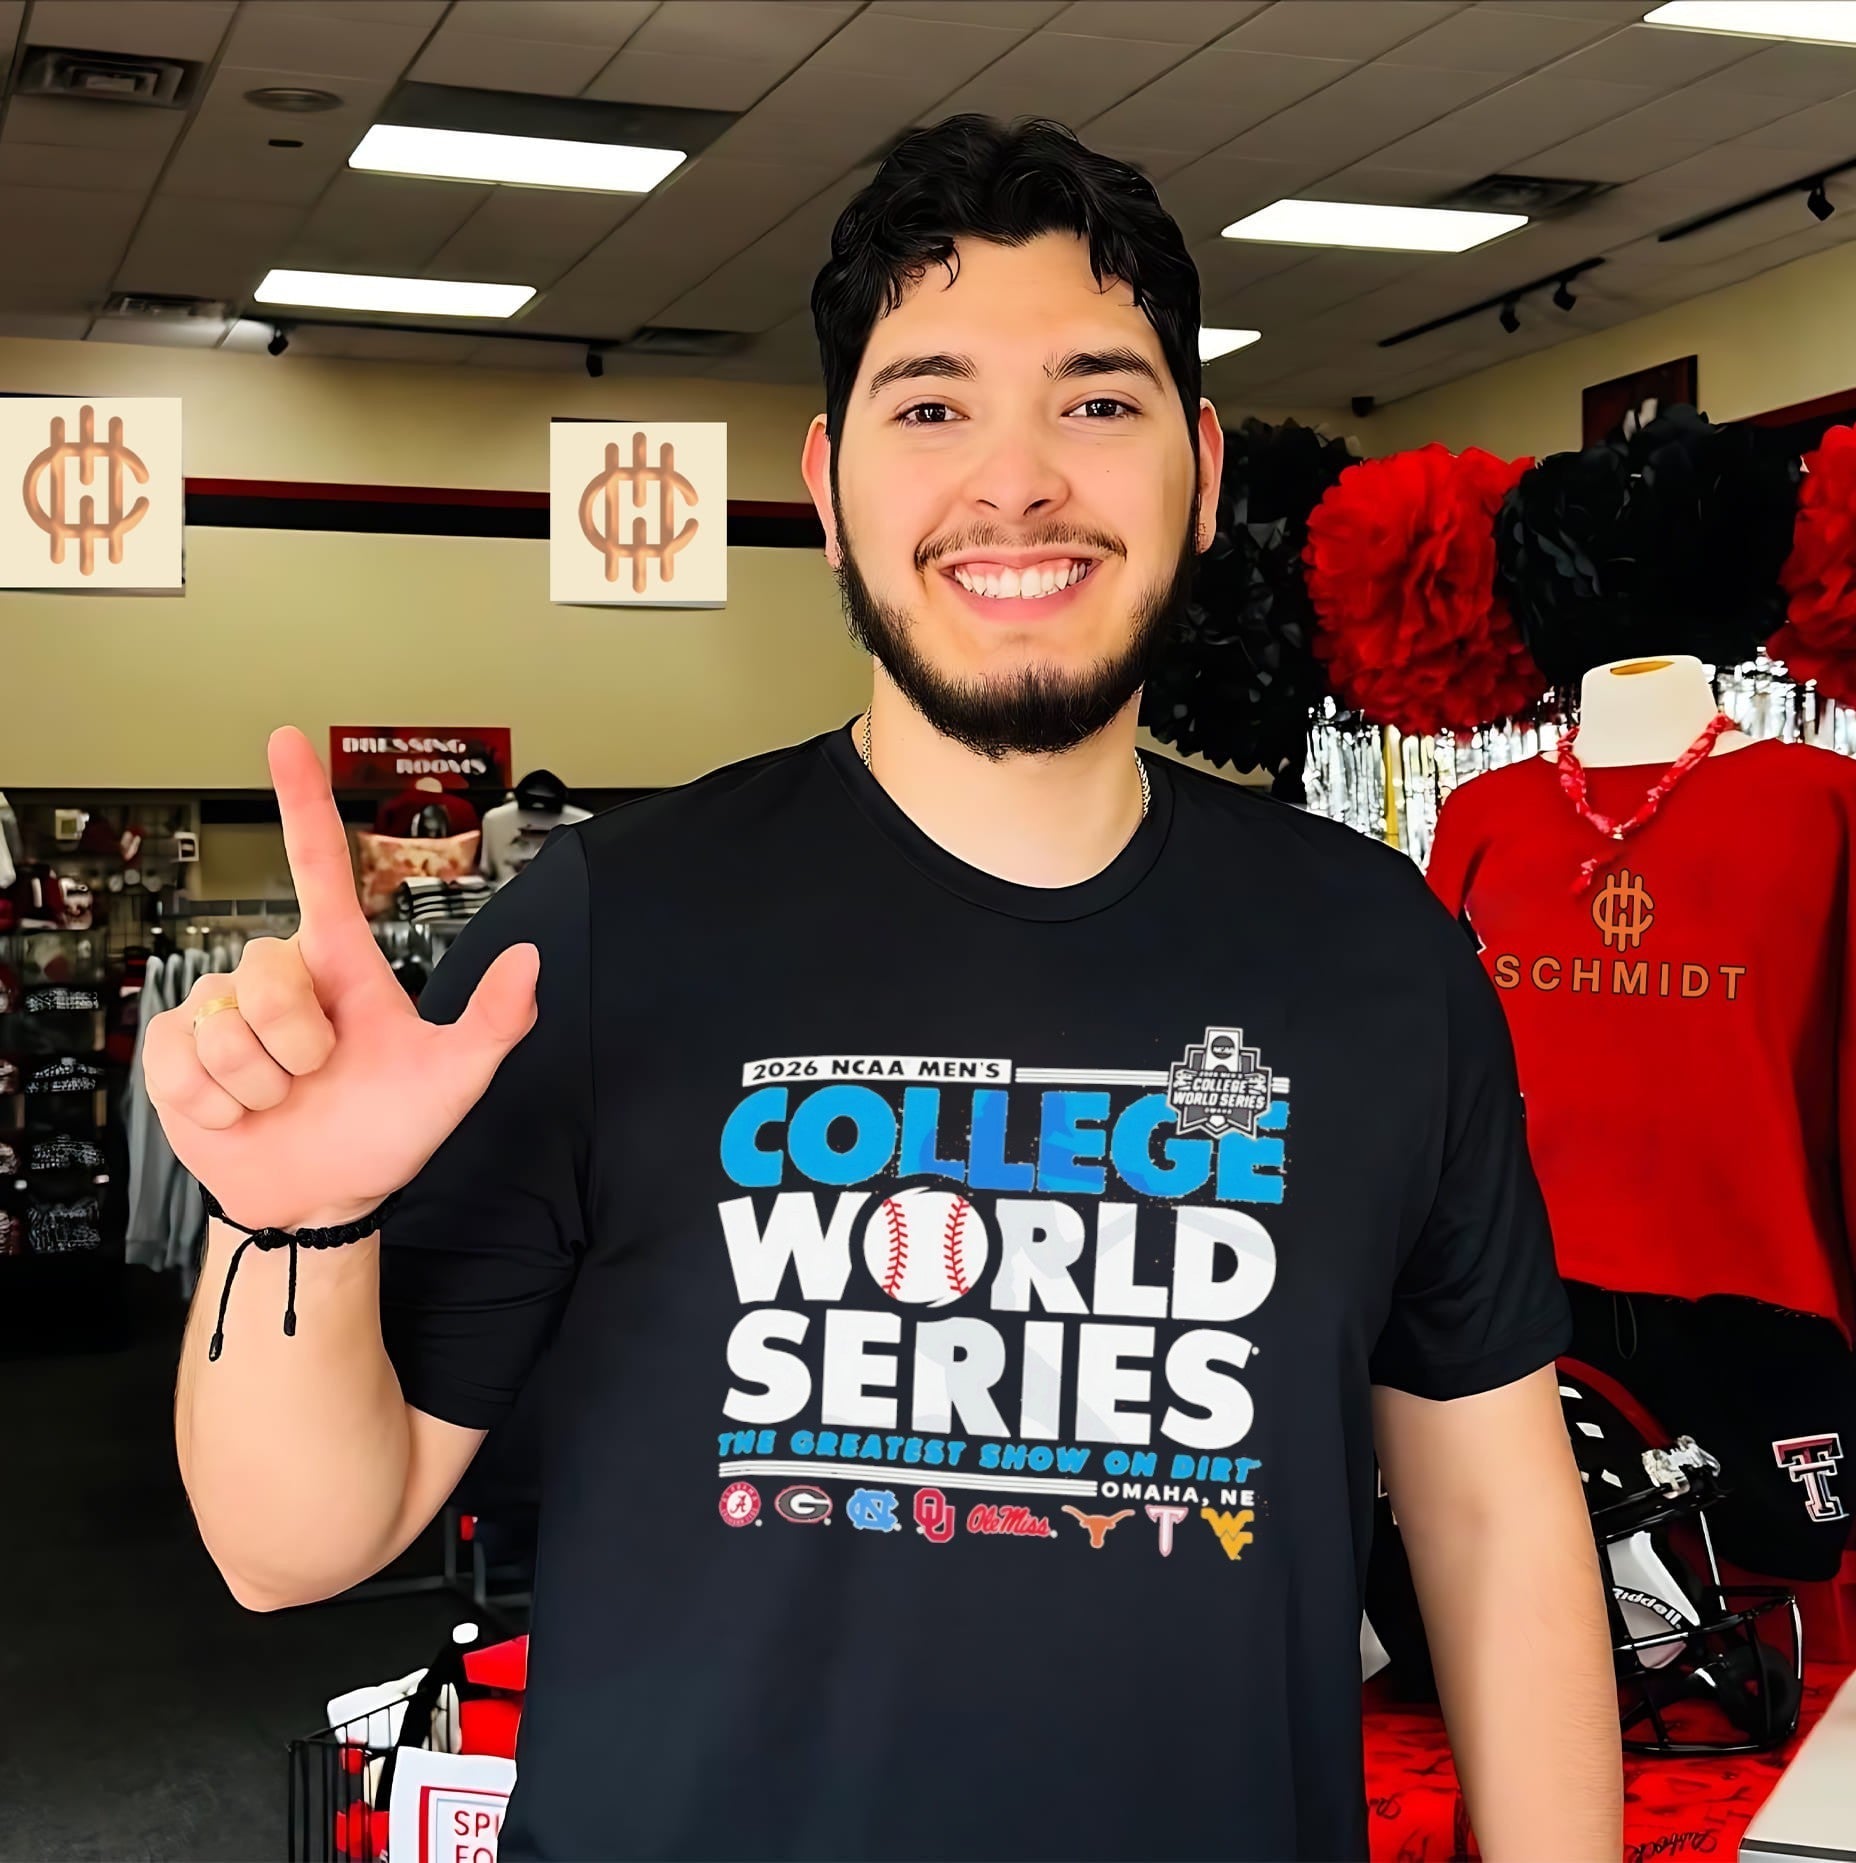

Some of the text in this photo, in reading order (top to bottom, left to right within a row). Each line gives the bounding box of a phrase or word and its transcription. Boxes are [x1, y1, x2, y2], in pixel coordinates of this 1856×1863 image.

[1494, 954, 1747, 1000] SCHMIDT
[752, 1059, 1001, 1080] 2026 NCAA MEN'S
[1192, 1077, 1249, 1094] COLLEGE
[1173, 1091, 1266, 1110] WORLD SERIES
[720, 1084, 1290, 1204] COLLEGE
[718, 1187, 1277, 1322] WORLD
[722, 1309, 1255, 1450] SERIES
[718, 1430, 777, 1457] THE
[790, 1430, 967, 1466] GREATEST
[979, 1443, 1091, 1474] SHOW
[1103, 1450, 1158, 1477] ON
[1101, 1481, 1255, 1507] OMAHA, NE
